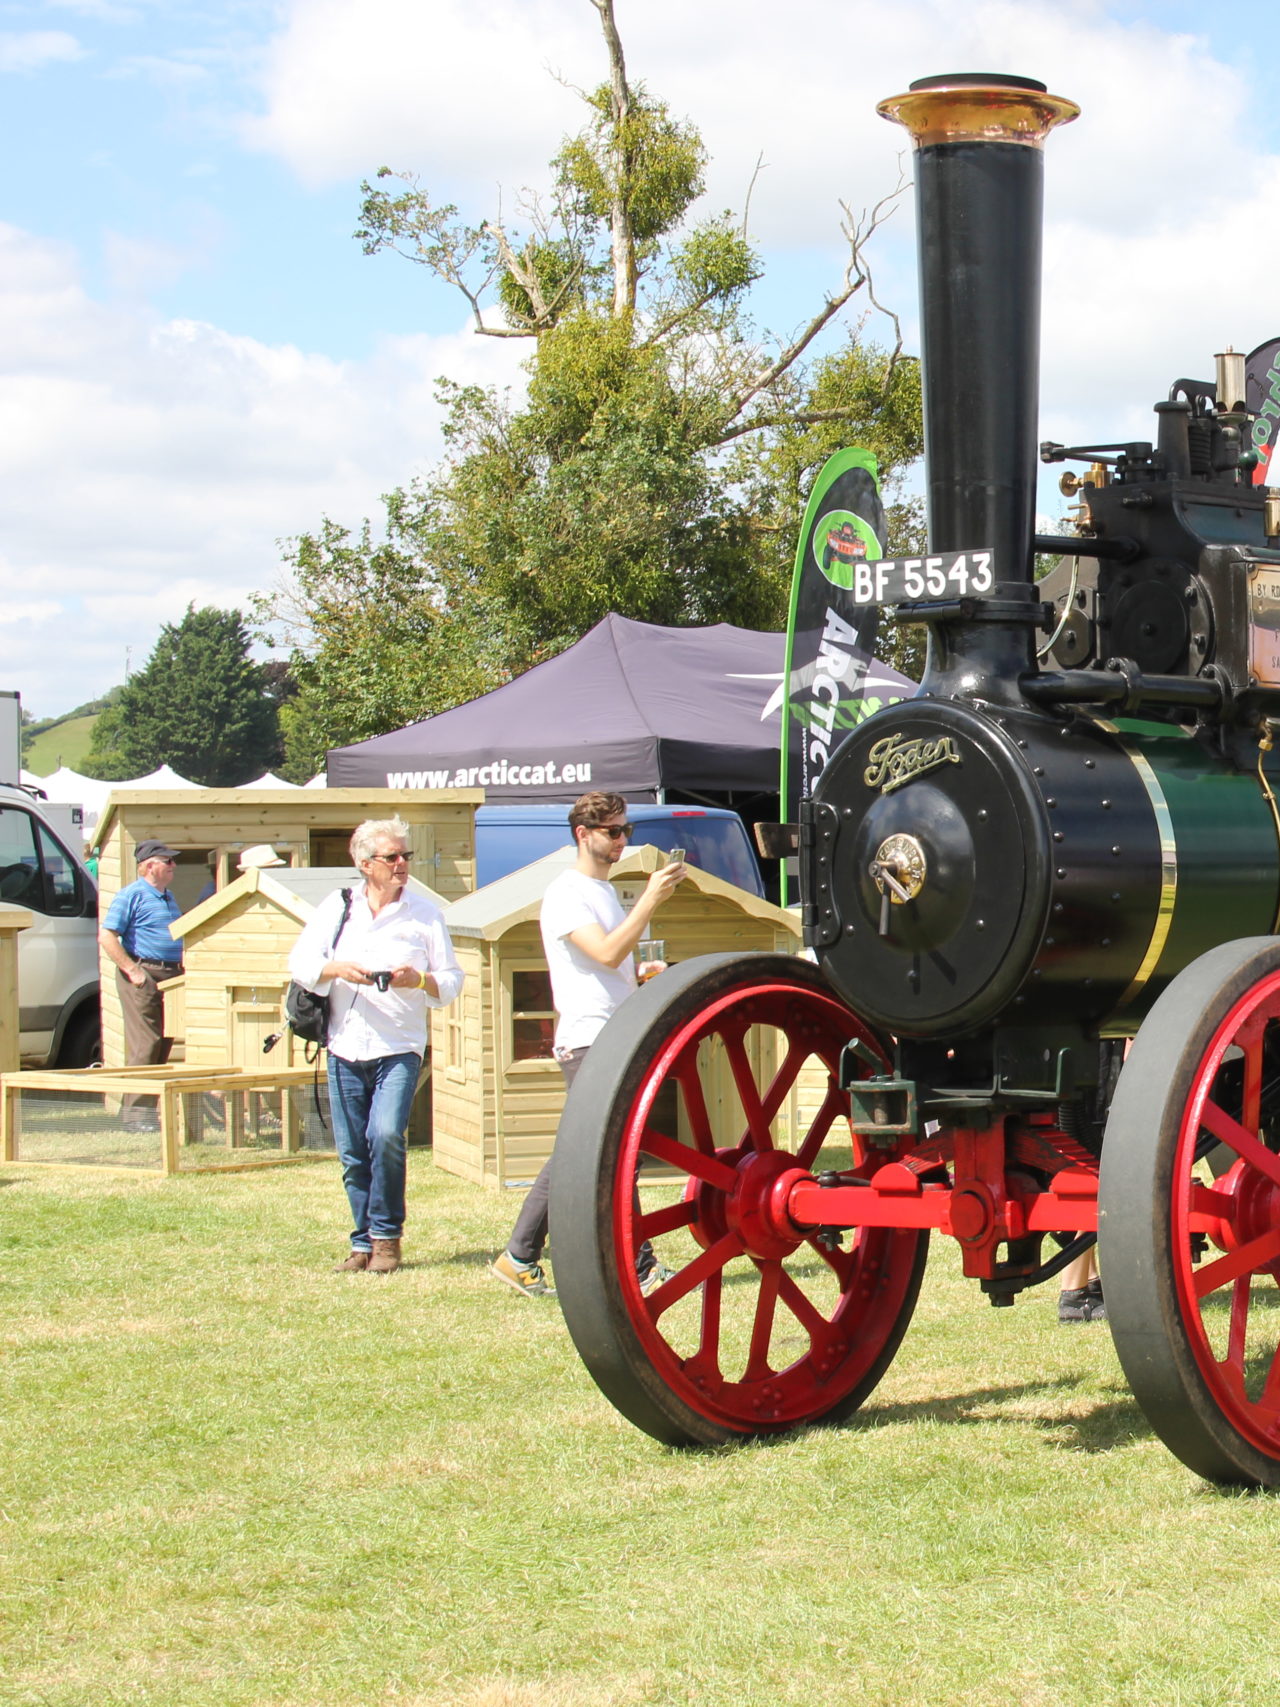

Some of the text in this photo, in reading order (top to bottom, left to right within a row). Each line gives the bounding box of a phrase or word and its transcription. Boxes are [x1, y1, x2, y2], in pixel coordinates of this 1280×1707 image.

[855, 552, 992, 603] BF 5543
[1257, 584, 1267, 597] BY
[809, 607, 858, 768] ARCTIC
[386, 759, 592, 789] www.arcticcat.eu
[864, 732, 960, 794] Foden
